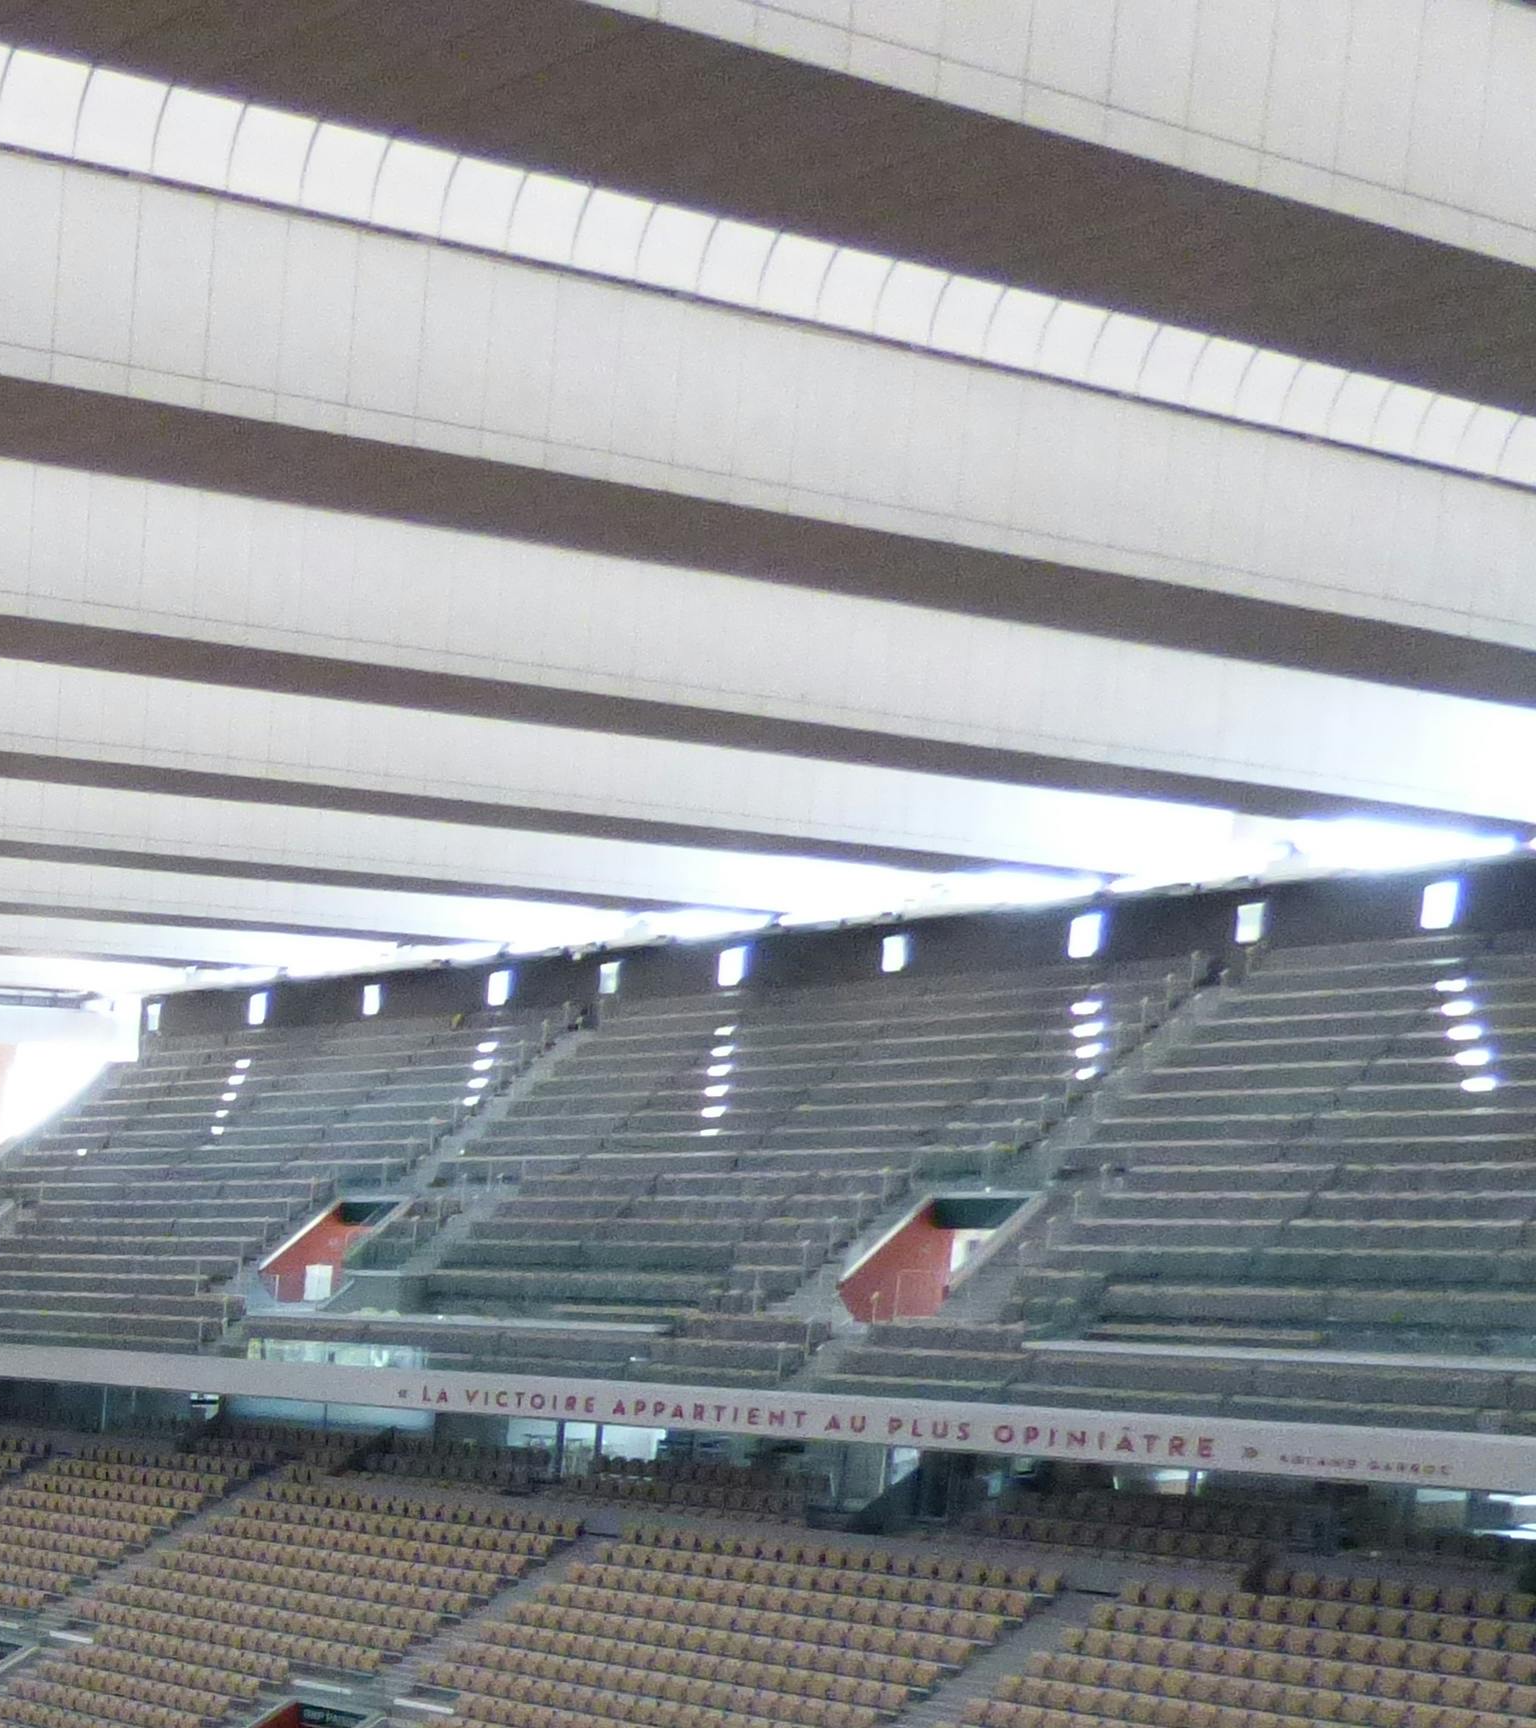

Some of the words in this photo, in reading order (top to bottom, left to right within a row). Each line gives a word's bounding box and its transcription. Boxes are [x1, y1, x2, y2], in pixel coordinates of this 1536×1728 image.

[422, 1385, 449, 1404] LA
[465, 1388, 595, 1414] VICTOIRE
[612, 1399, 808, 1429] APPARTIENT
[824, 1414, 867, 1434] AU
[888, 1418, 971, 1442] PLUS
[994, 1424, 1216, 1459] OPINIÂTRE
